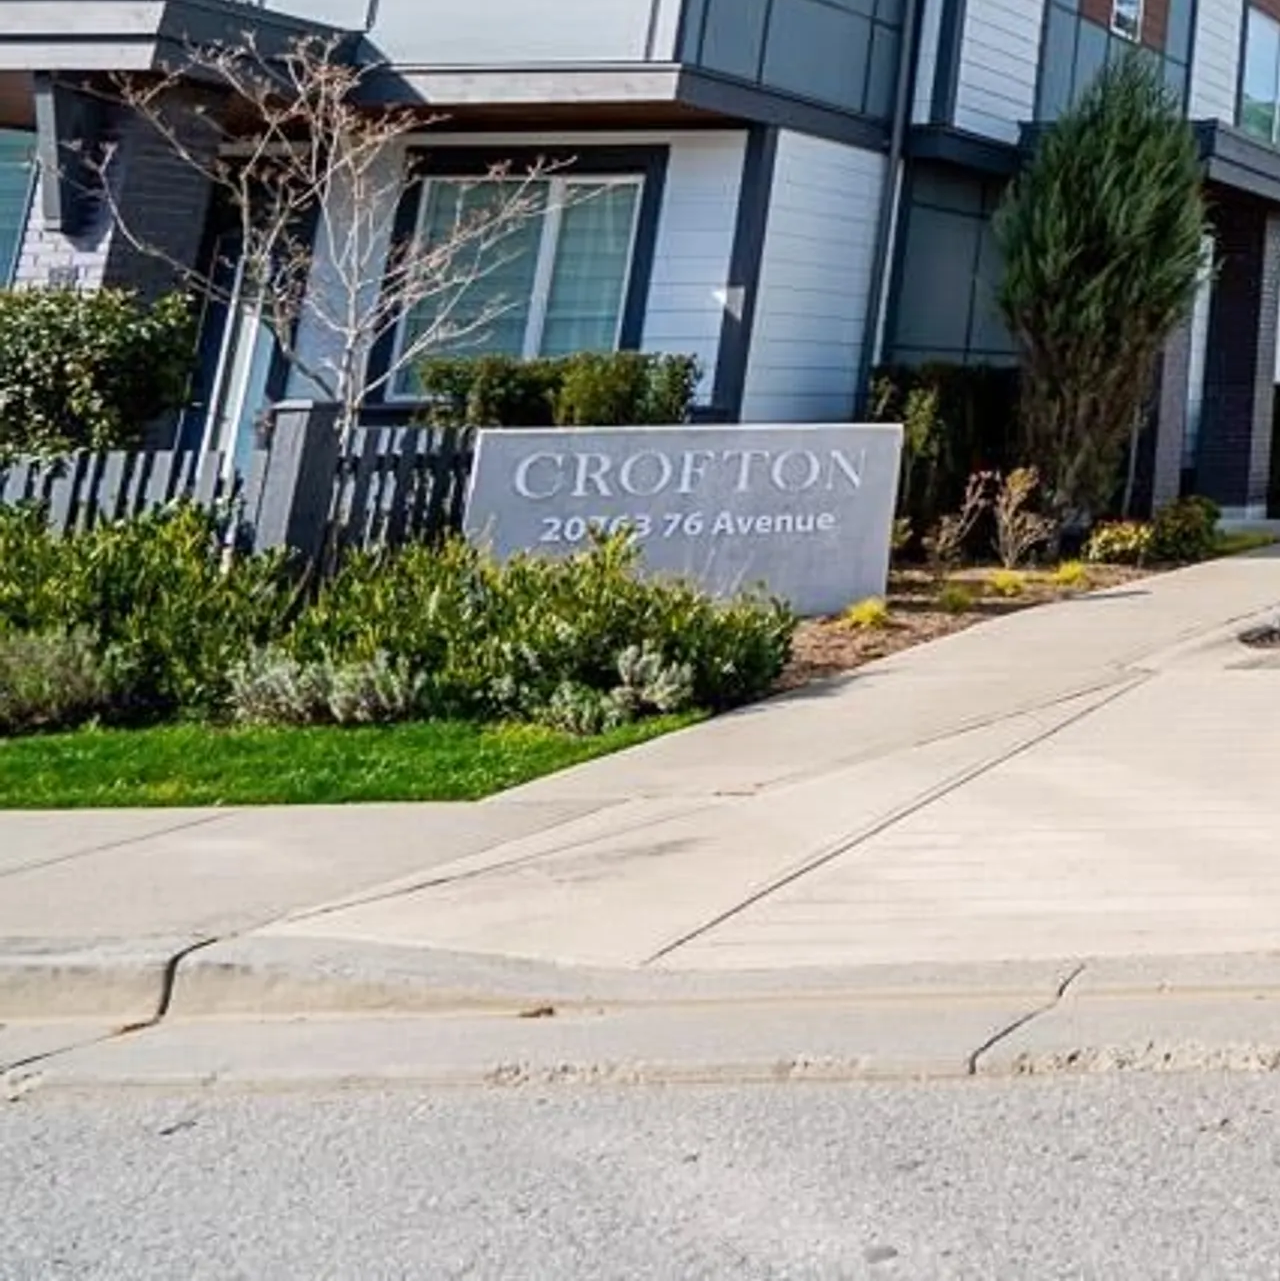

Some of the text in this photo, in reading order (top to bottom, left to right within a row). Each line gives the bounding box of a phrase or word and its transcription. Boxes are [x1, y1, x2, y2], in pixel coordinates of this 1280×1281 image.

[515, 449, 866, 499] CROFTON
[662, 511, 704, 538] 76
[711, 510, 836, 536] Avenue
